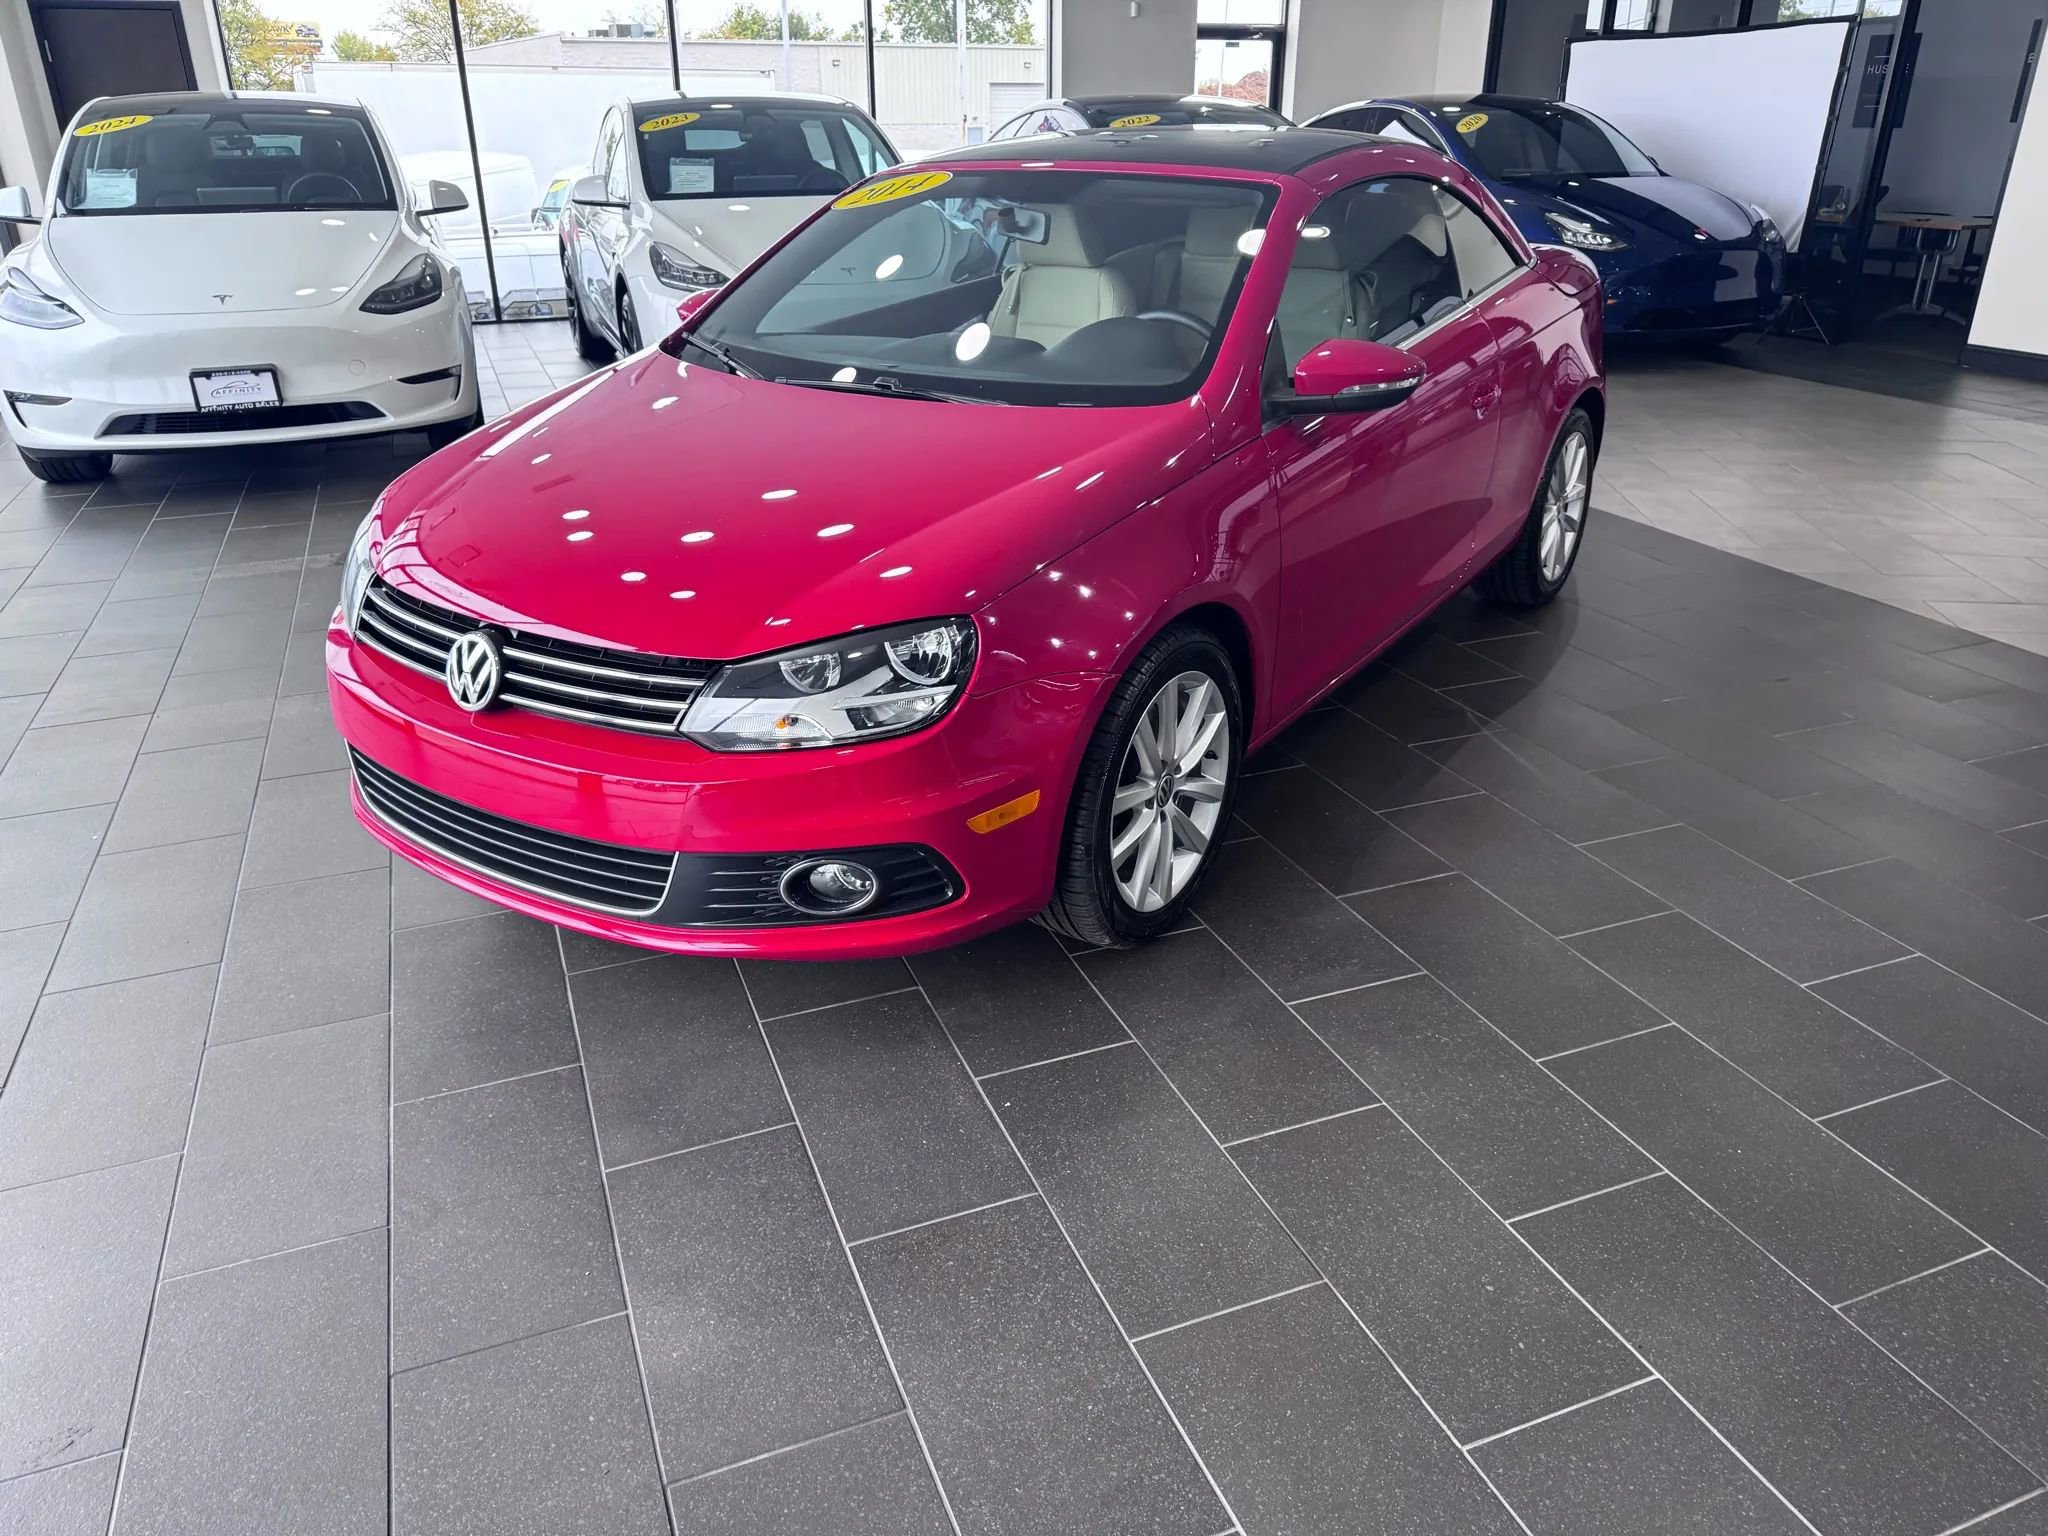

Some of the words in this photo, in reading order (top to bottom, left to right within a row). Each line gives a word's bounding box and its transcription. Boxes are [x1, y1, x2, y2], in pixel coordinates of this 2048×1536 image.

[88, 116, 137, 133] 2024
[651, 114, 688, 129] 2023
[1120, 115, 1151, 127] 2022
[1461, 115, 1482, 130] 2020
[847, 174, 937, 206] 2014
[215, 387, 261, 395] AFFINITY
[201, 405, 233, 413] AFFINITY
